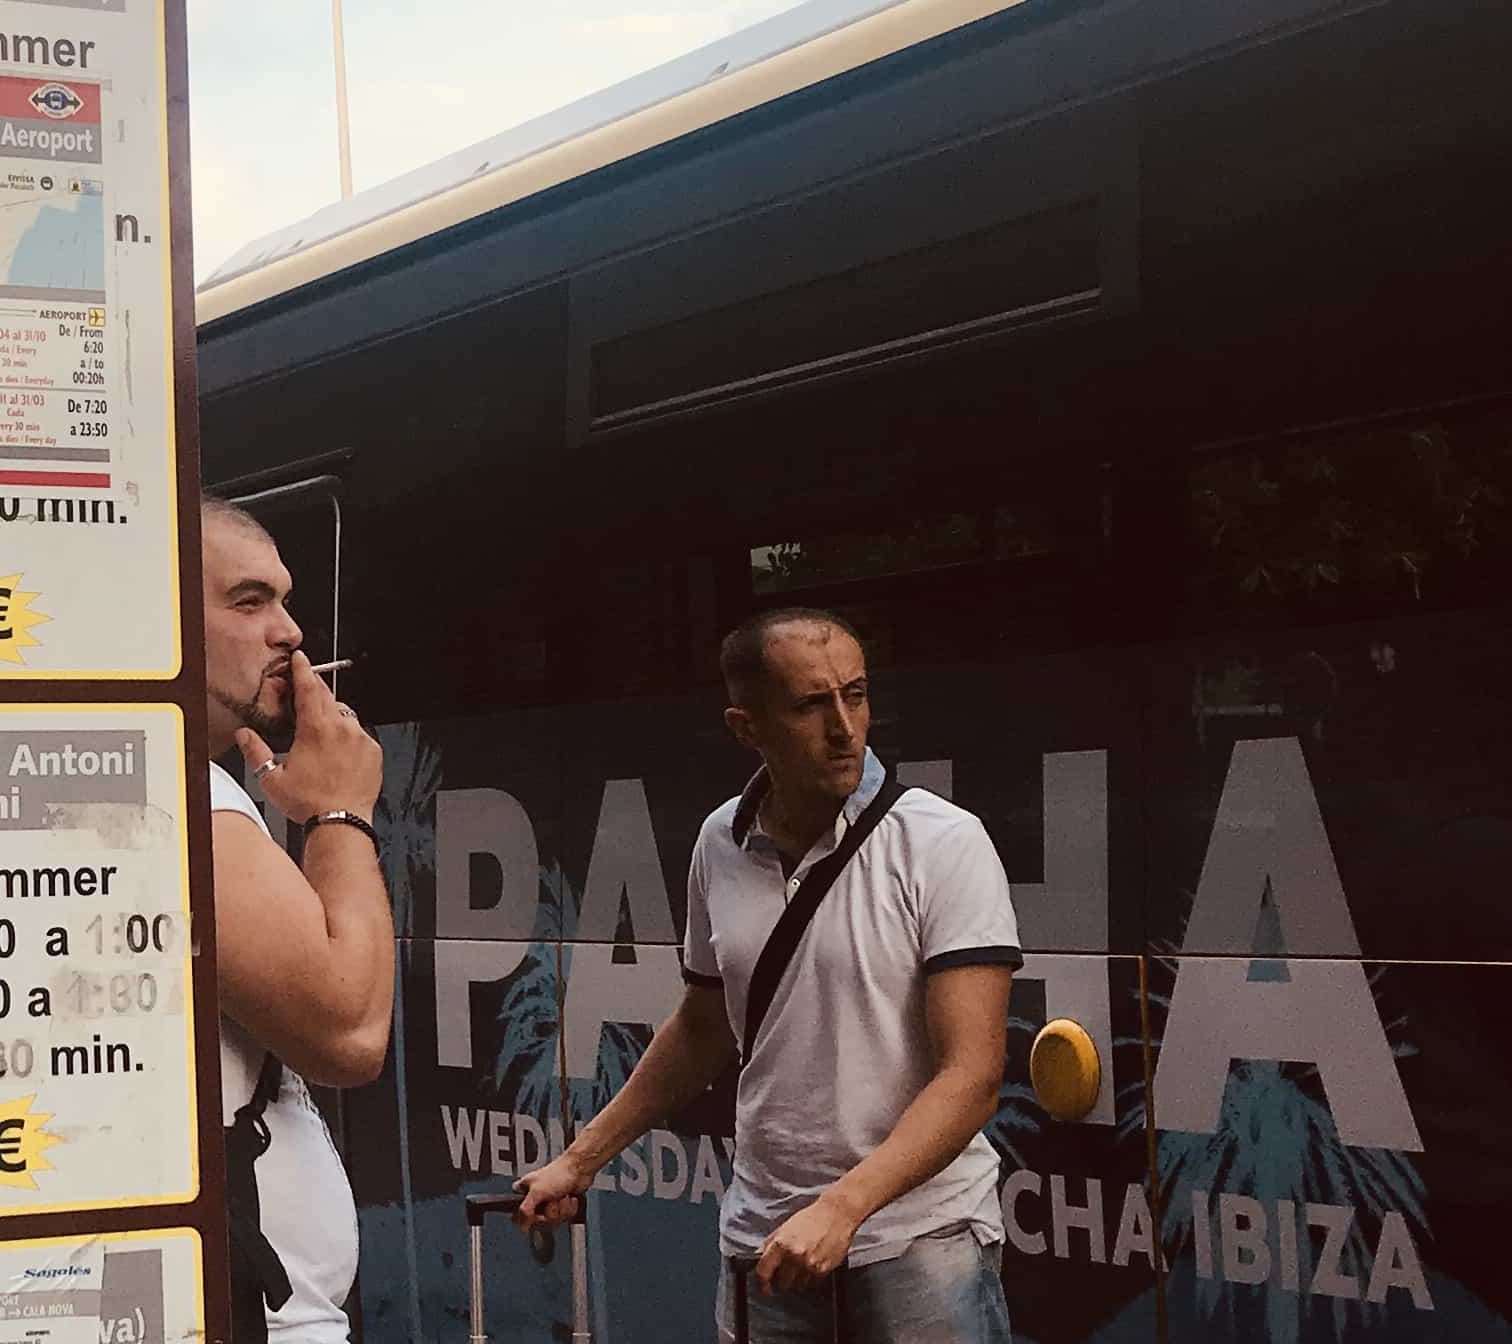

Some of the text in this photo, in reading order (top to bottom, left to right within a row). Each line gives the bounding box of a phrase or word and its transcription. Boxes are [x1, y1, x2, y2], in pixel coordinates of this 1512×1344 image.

[0, 122, 94, 157] Aeroport
[39, 310, 86, 321] AEROPORT
[59, 324, 103, 339] De From
[84, 341, 104, 354] 6:20
[68, 399, 107, 414] De 7:20
[80, 423, 108, 437] 23:50
[8, 742, 134, 777] Antoni
[45, 926, 70, 957] a
[435, 737, 1424, 1153] PAHA
[28, 987, 52, 1017] a
[50, 1034, 145, 1077] min.
[1192, 1189, 1435, 1311] IBIZA
